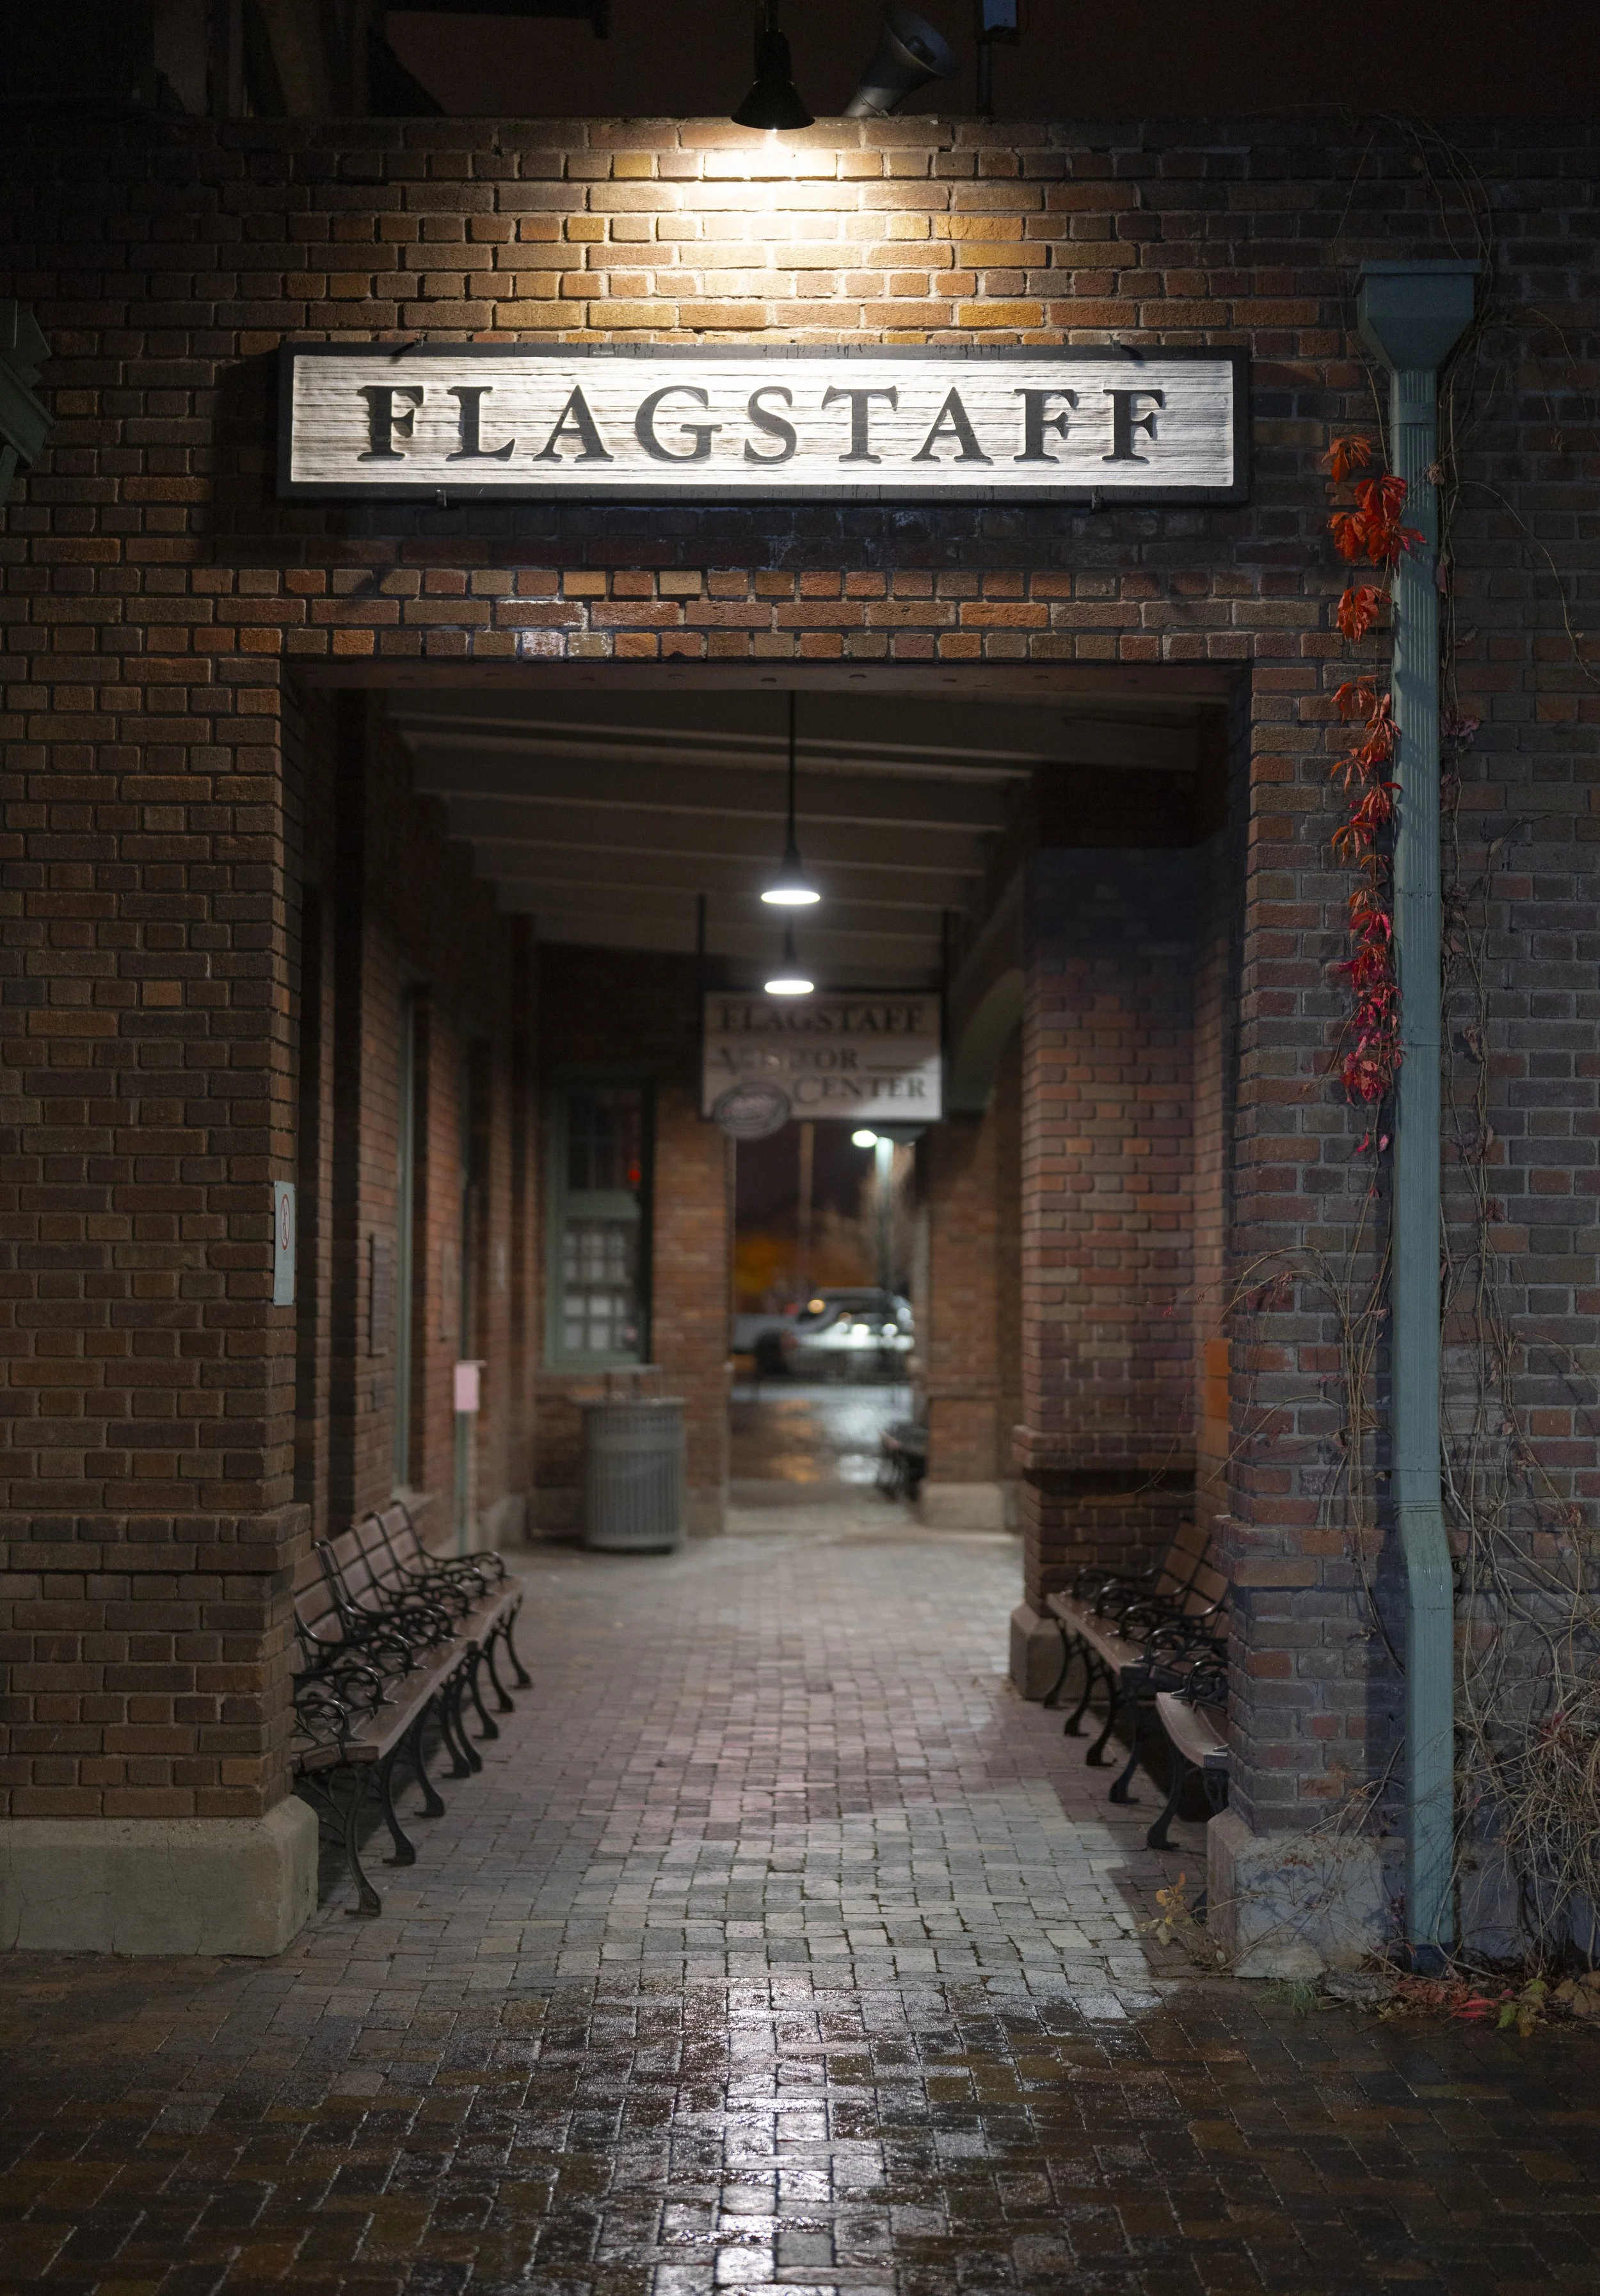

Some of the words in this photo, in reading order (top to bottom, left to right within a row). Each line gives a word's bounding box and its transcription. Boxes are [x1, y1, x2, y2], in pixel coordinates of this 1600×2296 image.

[356, 385, 1165, 464] FLAGSTAFF
[720, 1003, 925, 1033] FLAGSTAFF
[719, 1046, 860, 1076] VSTOR
[793, 1074, 927, 1104] CENTER
